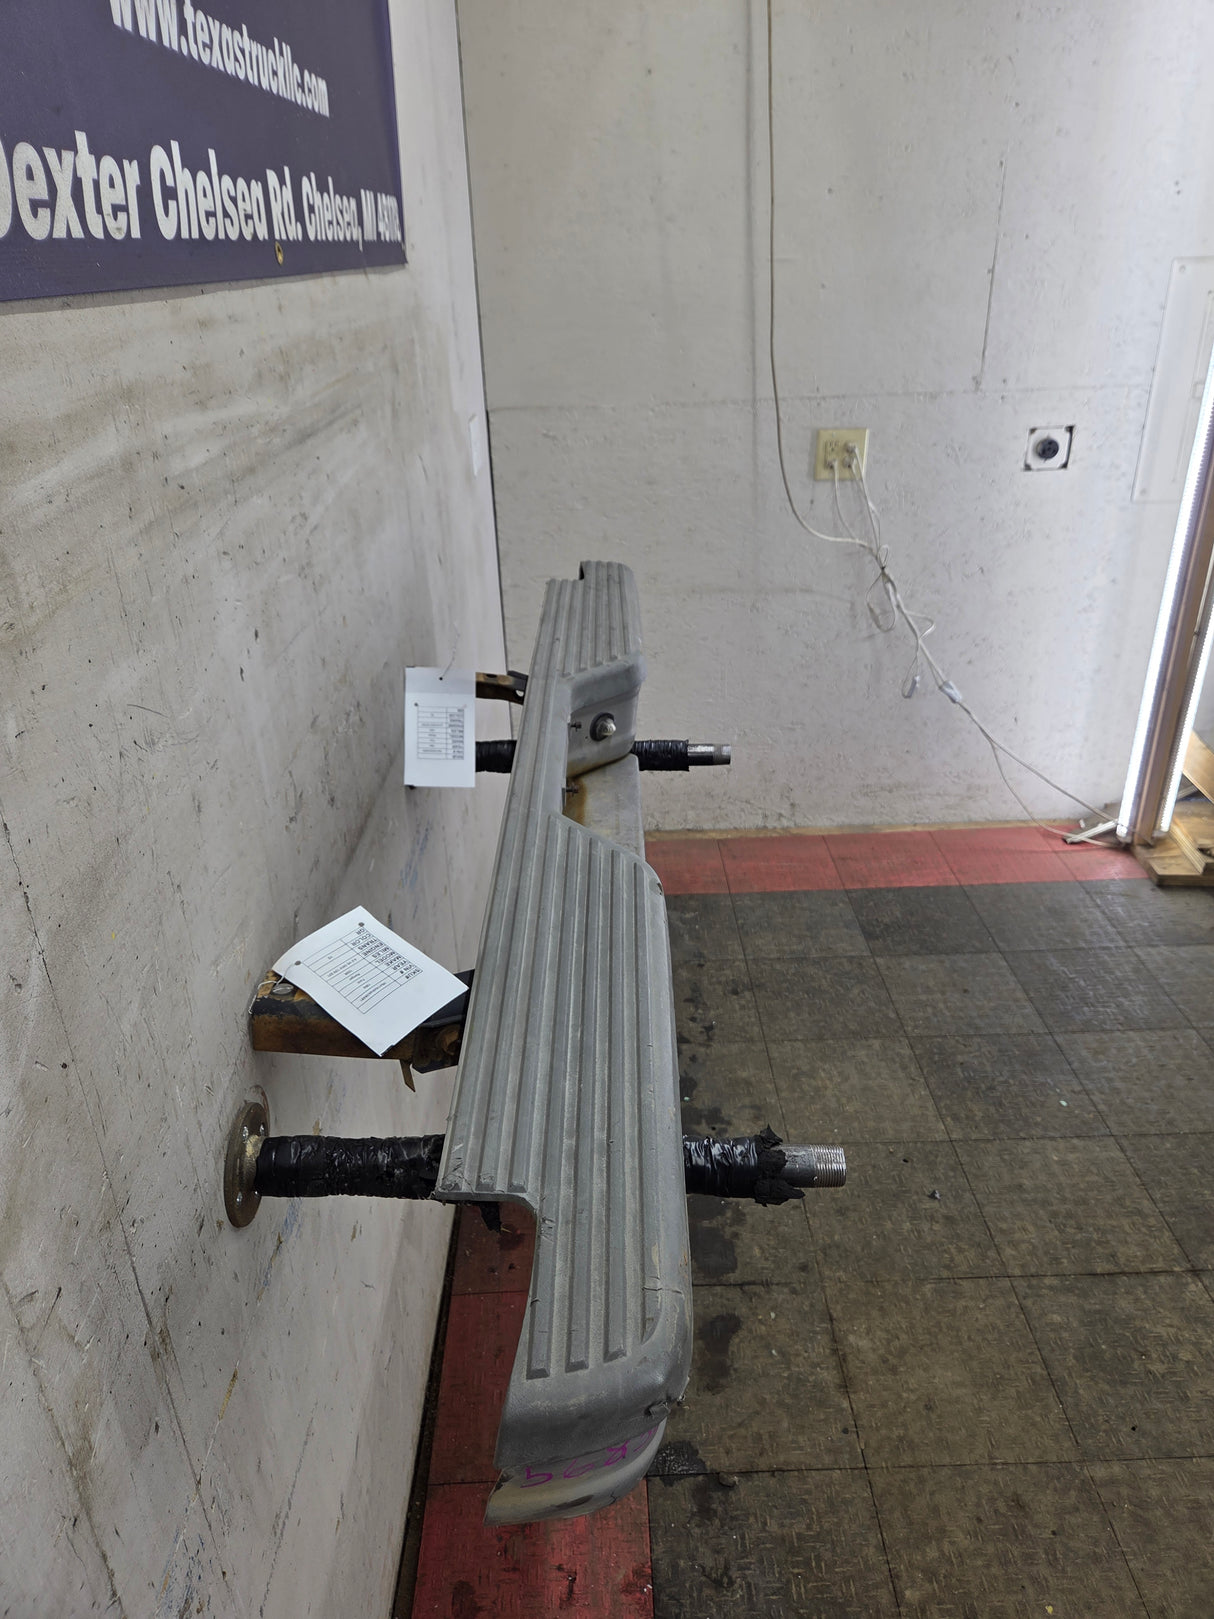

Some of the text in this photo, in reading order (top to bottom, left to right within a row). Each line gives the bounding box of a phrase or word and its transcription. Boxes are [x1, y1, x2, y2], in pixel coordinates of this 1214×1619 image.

[0, 130, 141, 240] exter
[150, 140, 268, 240] Chelsea
[266, 166, 302, 241] Rd.
[302, 171, 363, 252] Chelsea,
[351, 933, 371, 946] COLOR
[358, 939, 377, 950] TRANS
[363, 942, 384, 956] ENGINE
[372, 947, 389, 958] MILES
[375, 951, 396, 964] MODEL
[385, 955, 401, 966] MAKE
[392, 960, 407, 970] YEAR
